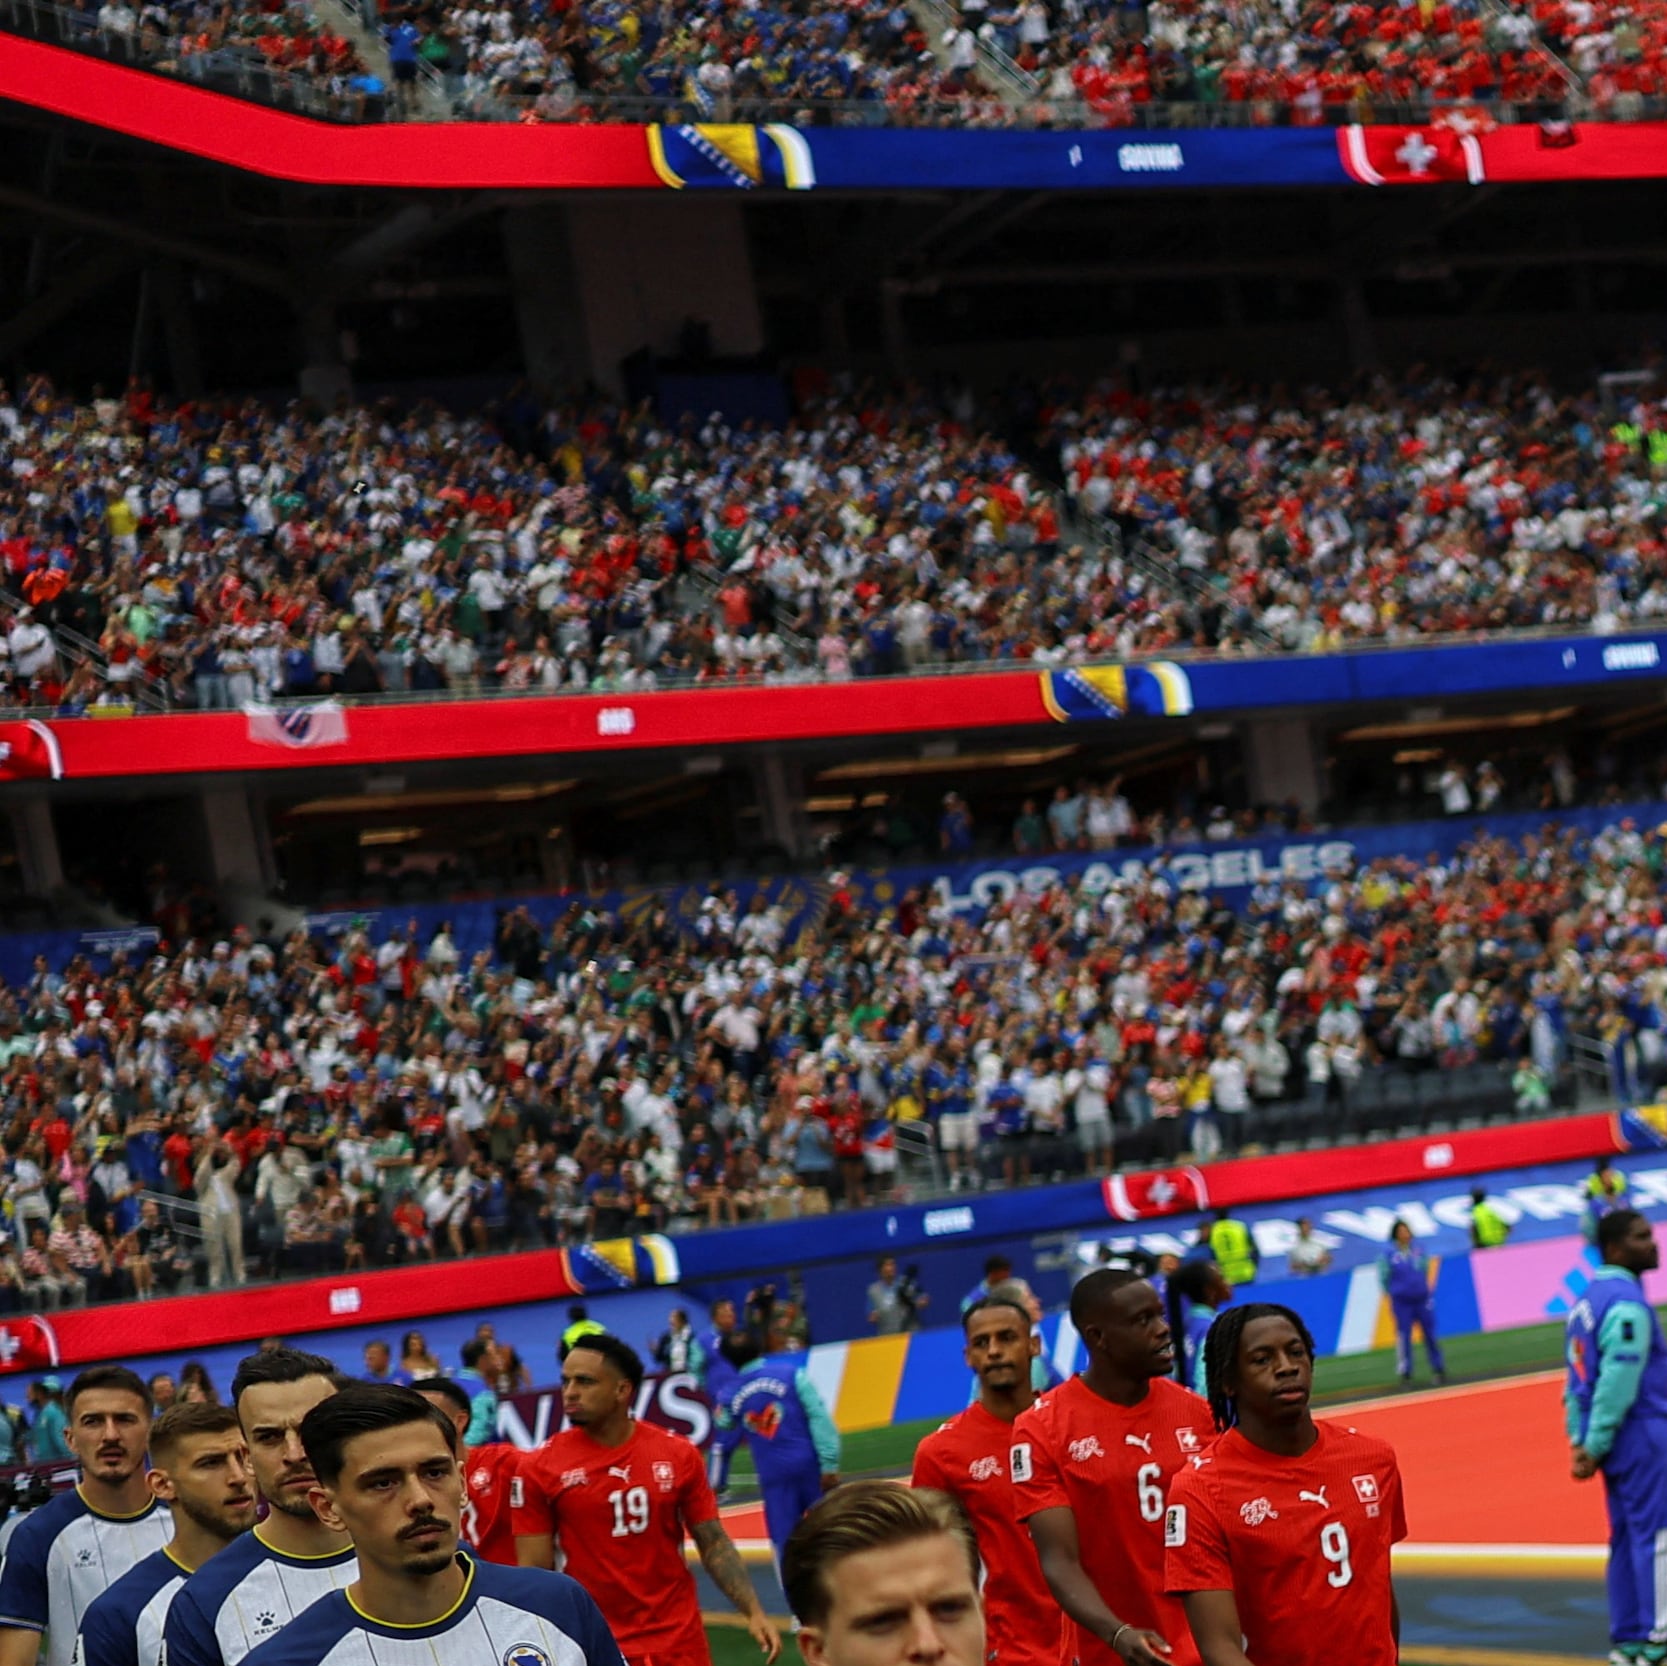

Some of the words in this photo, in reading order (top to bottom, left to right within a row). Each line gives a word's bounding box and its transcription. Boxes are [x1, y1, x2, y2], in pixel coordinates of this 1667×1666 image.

[608, 1486, 649, 1537] 19
[1138, 1462, 1164, 1522] 6
[1321, 1521, 1353, 1588] 9
